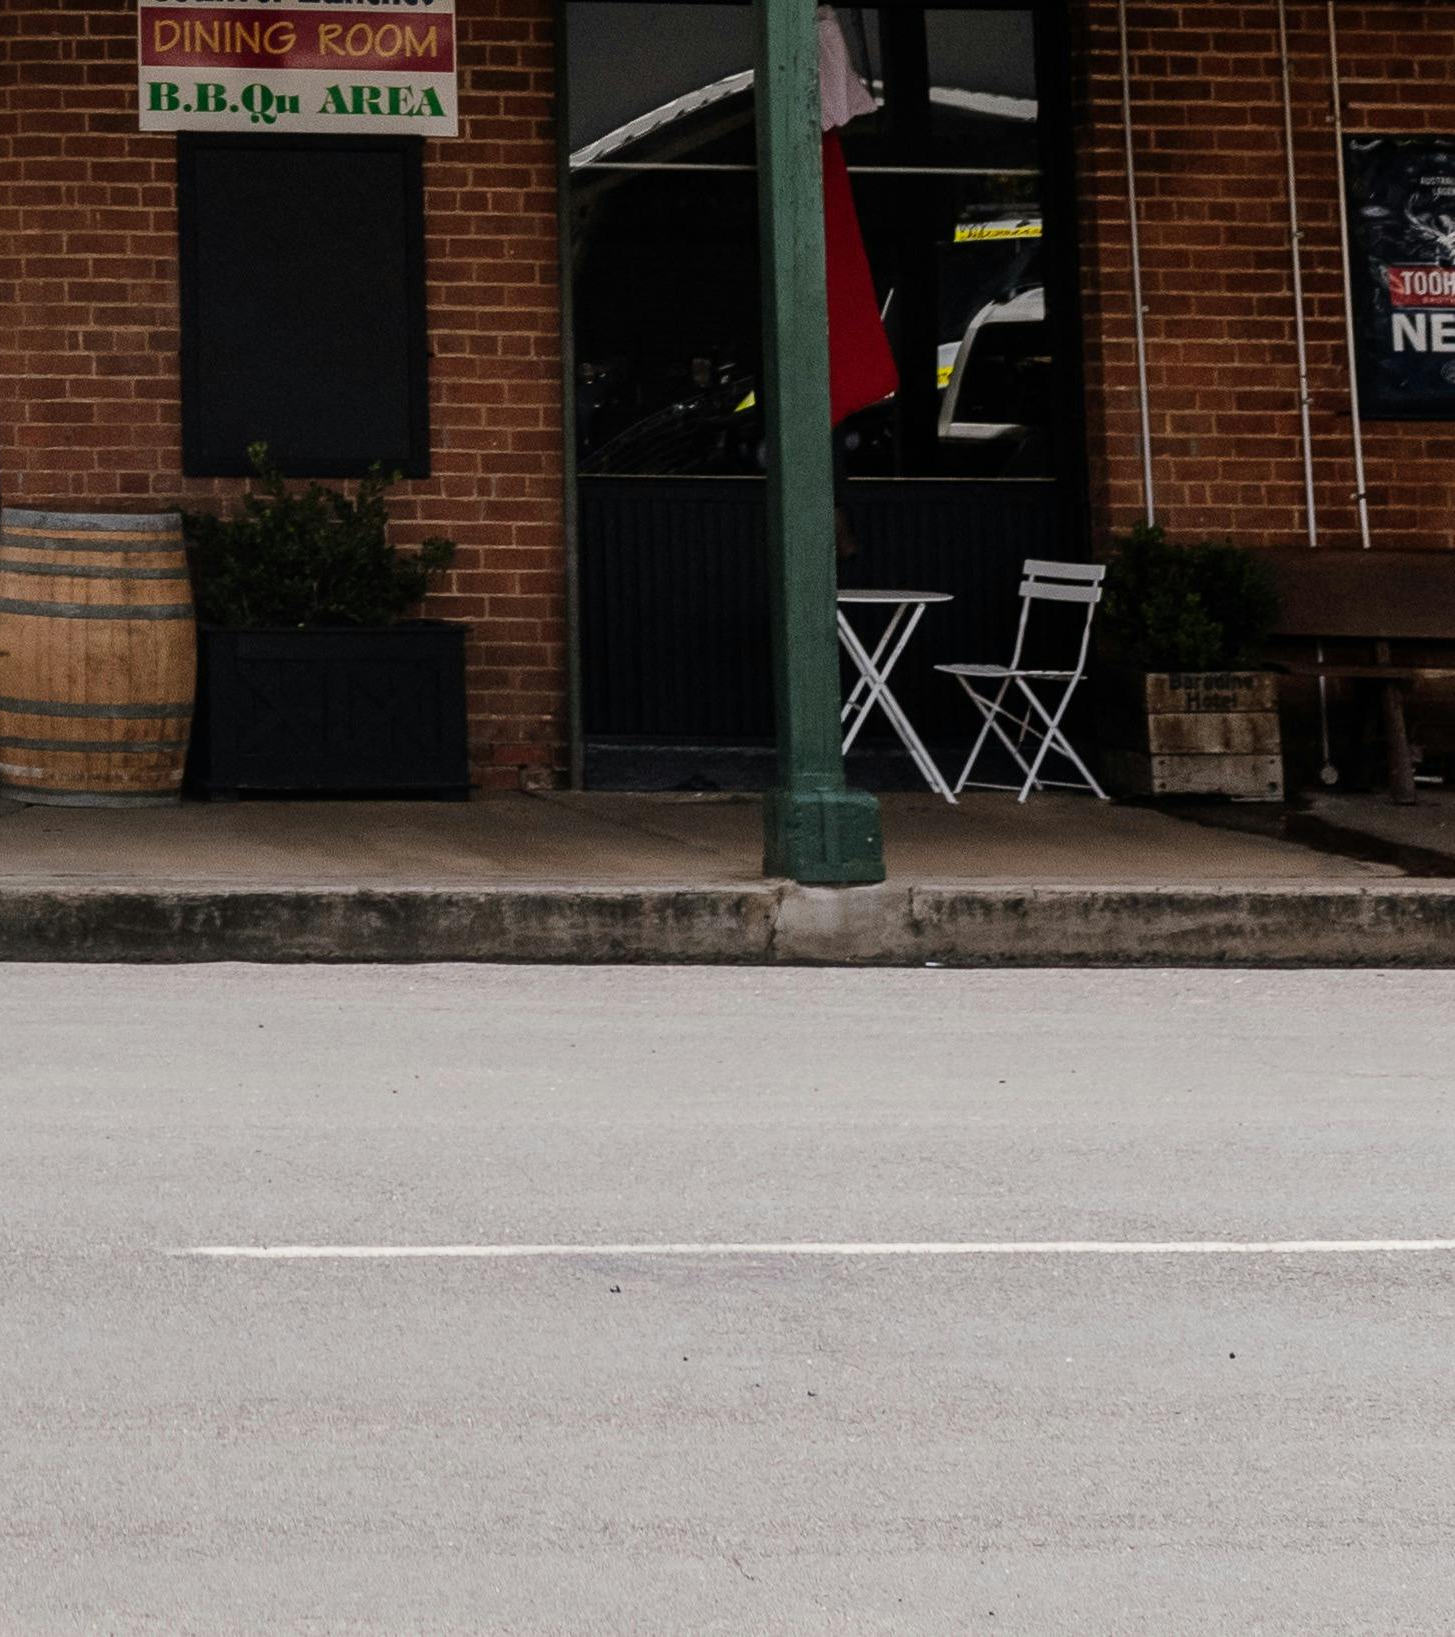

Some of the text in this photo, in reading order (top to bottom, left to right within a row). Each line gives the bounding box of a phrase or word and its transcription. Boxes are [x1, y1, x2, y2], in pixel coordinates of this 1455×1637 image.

[153, 19, 438, 59] DINING ROOM
[145, 82, 447, 125] B.B.Qu AREA
